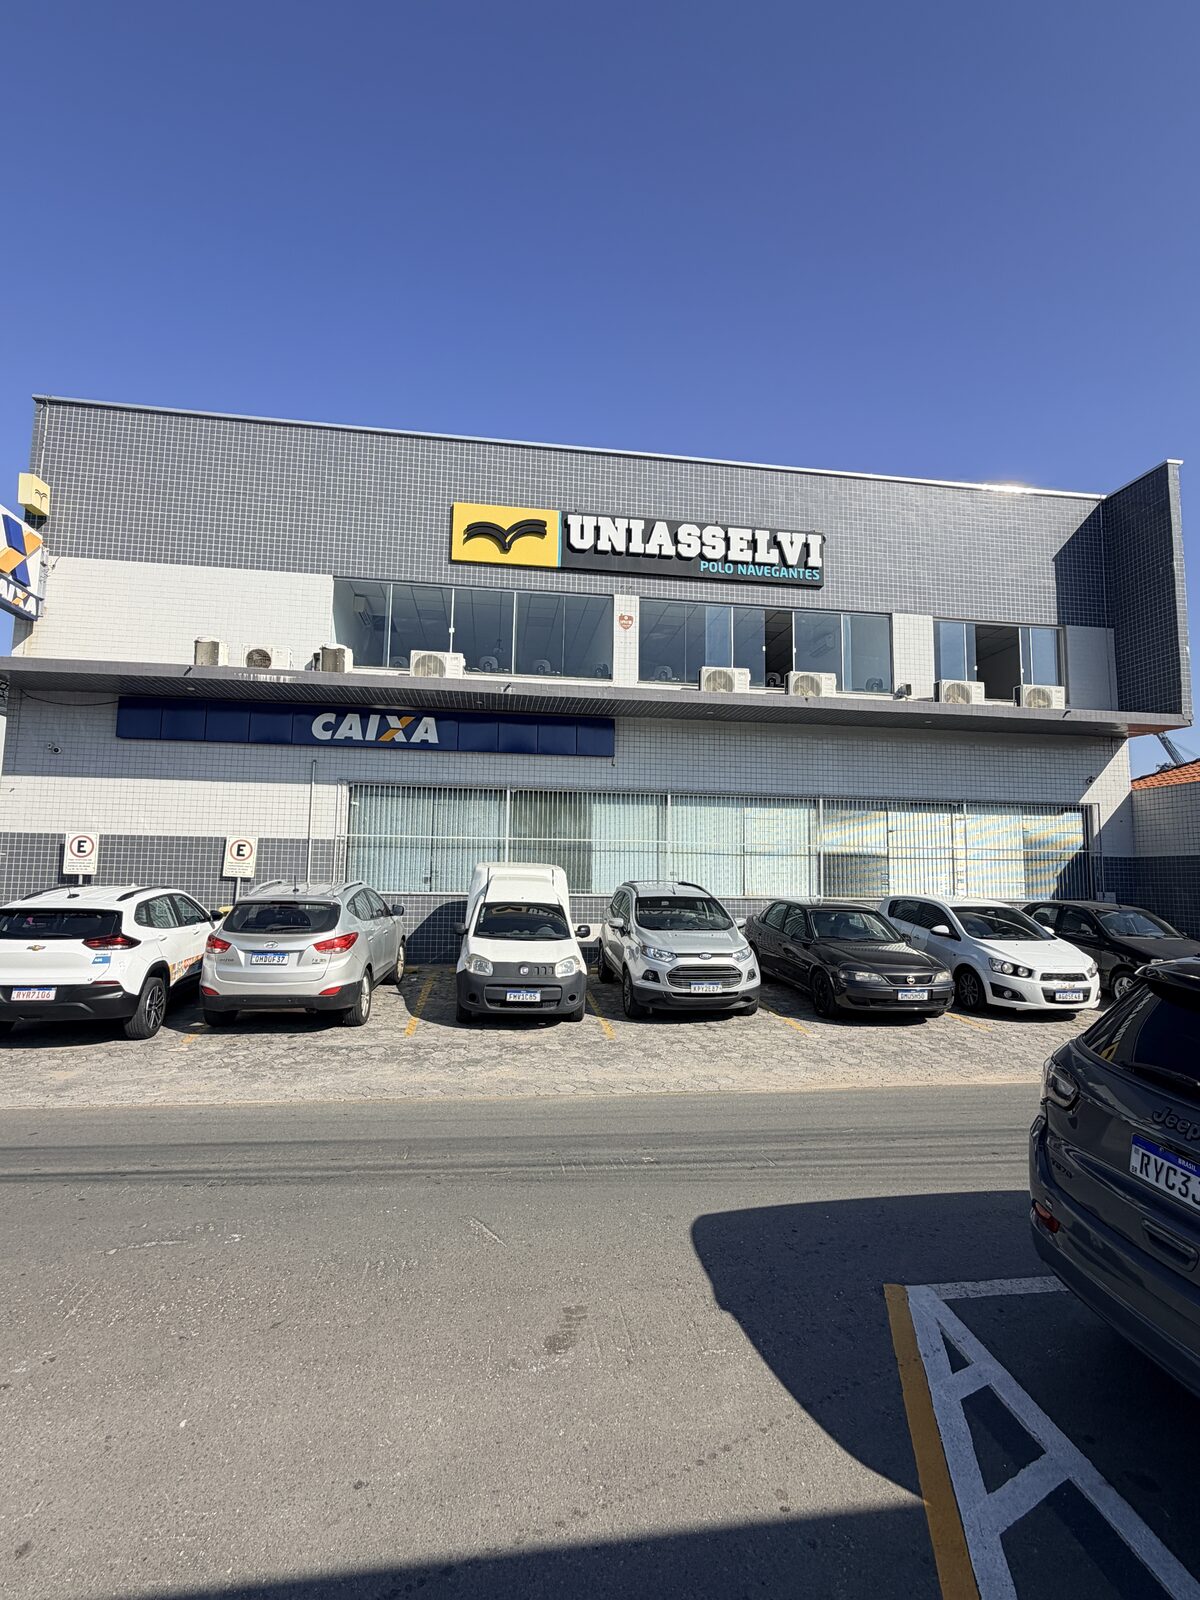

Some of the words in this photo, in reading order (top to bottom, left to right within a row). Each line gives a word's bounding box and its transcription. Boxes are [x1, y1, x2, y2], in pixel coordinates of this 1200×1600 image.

[566, 514, 823, 568] UNIASSELVI
[700, 560, 734, 574] POLO
[738, 563, 821, 581] NAVEGANTES
[311, 712, 440, 744] CAIXA
[77, 840, 87, 853] E
[236, 844, 246, 857] E
[1151, 1106, 1200, 1141] Jeep
[1177, 1157, 1198, 1173] BRASIL
